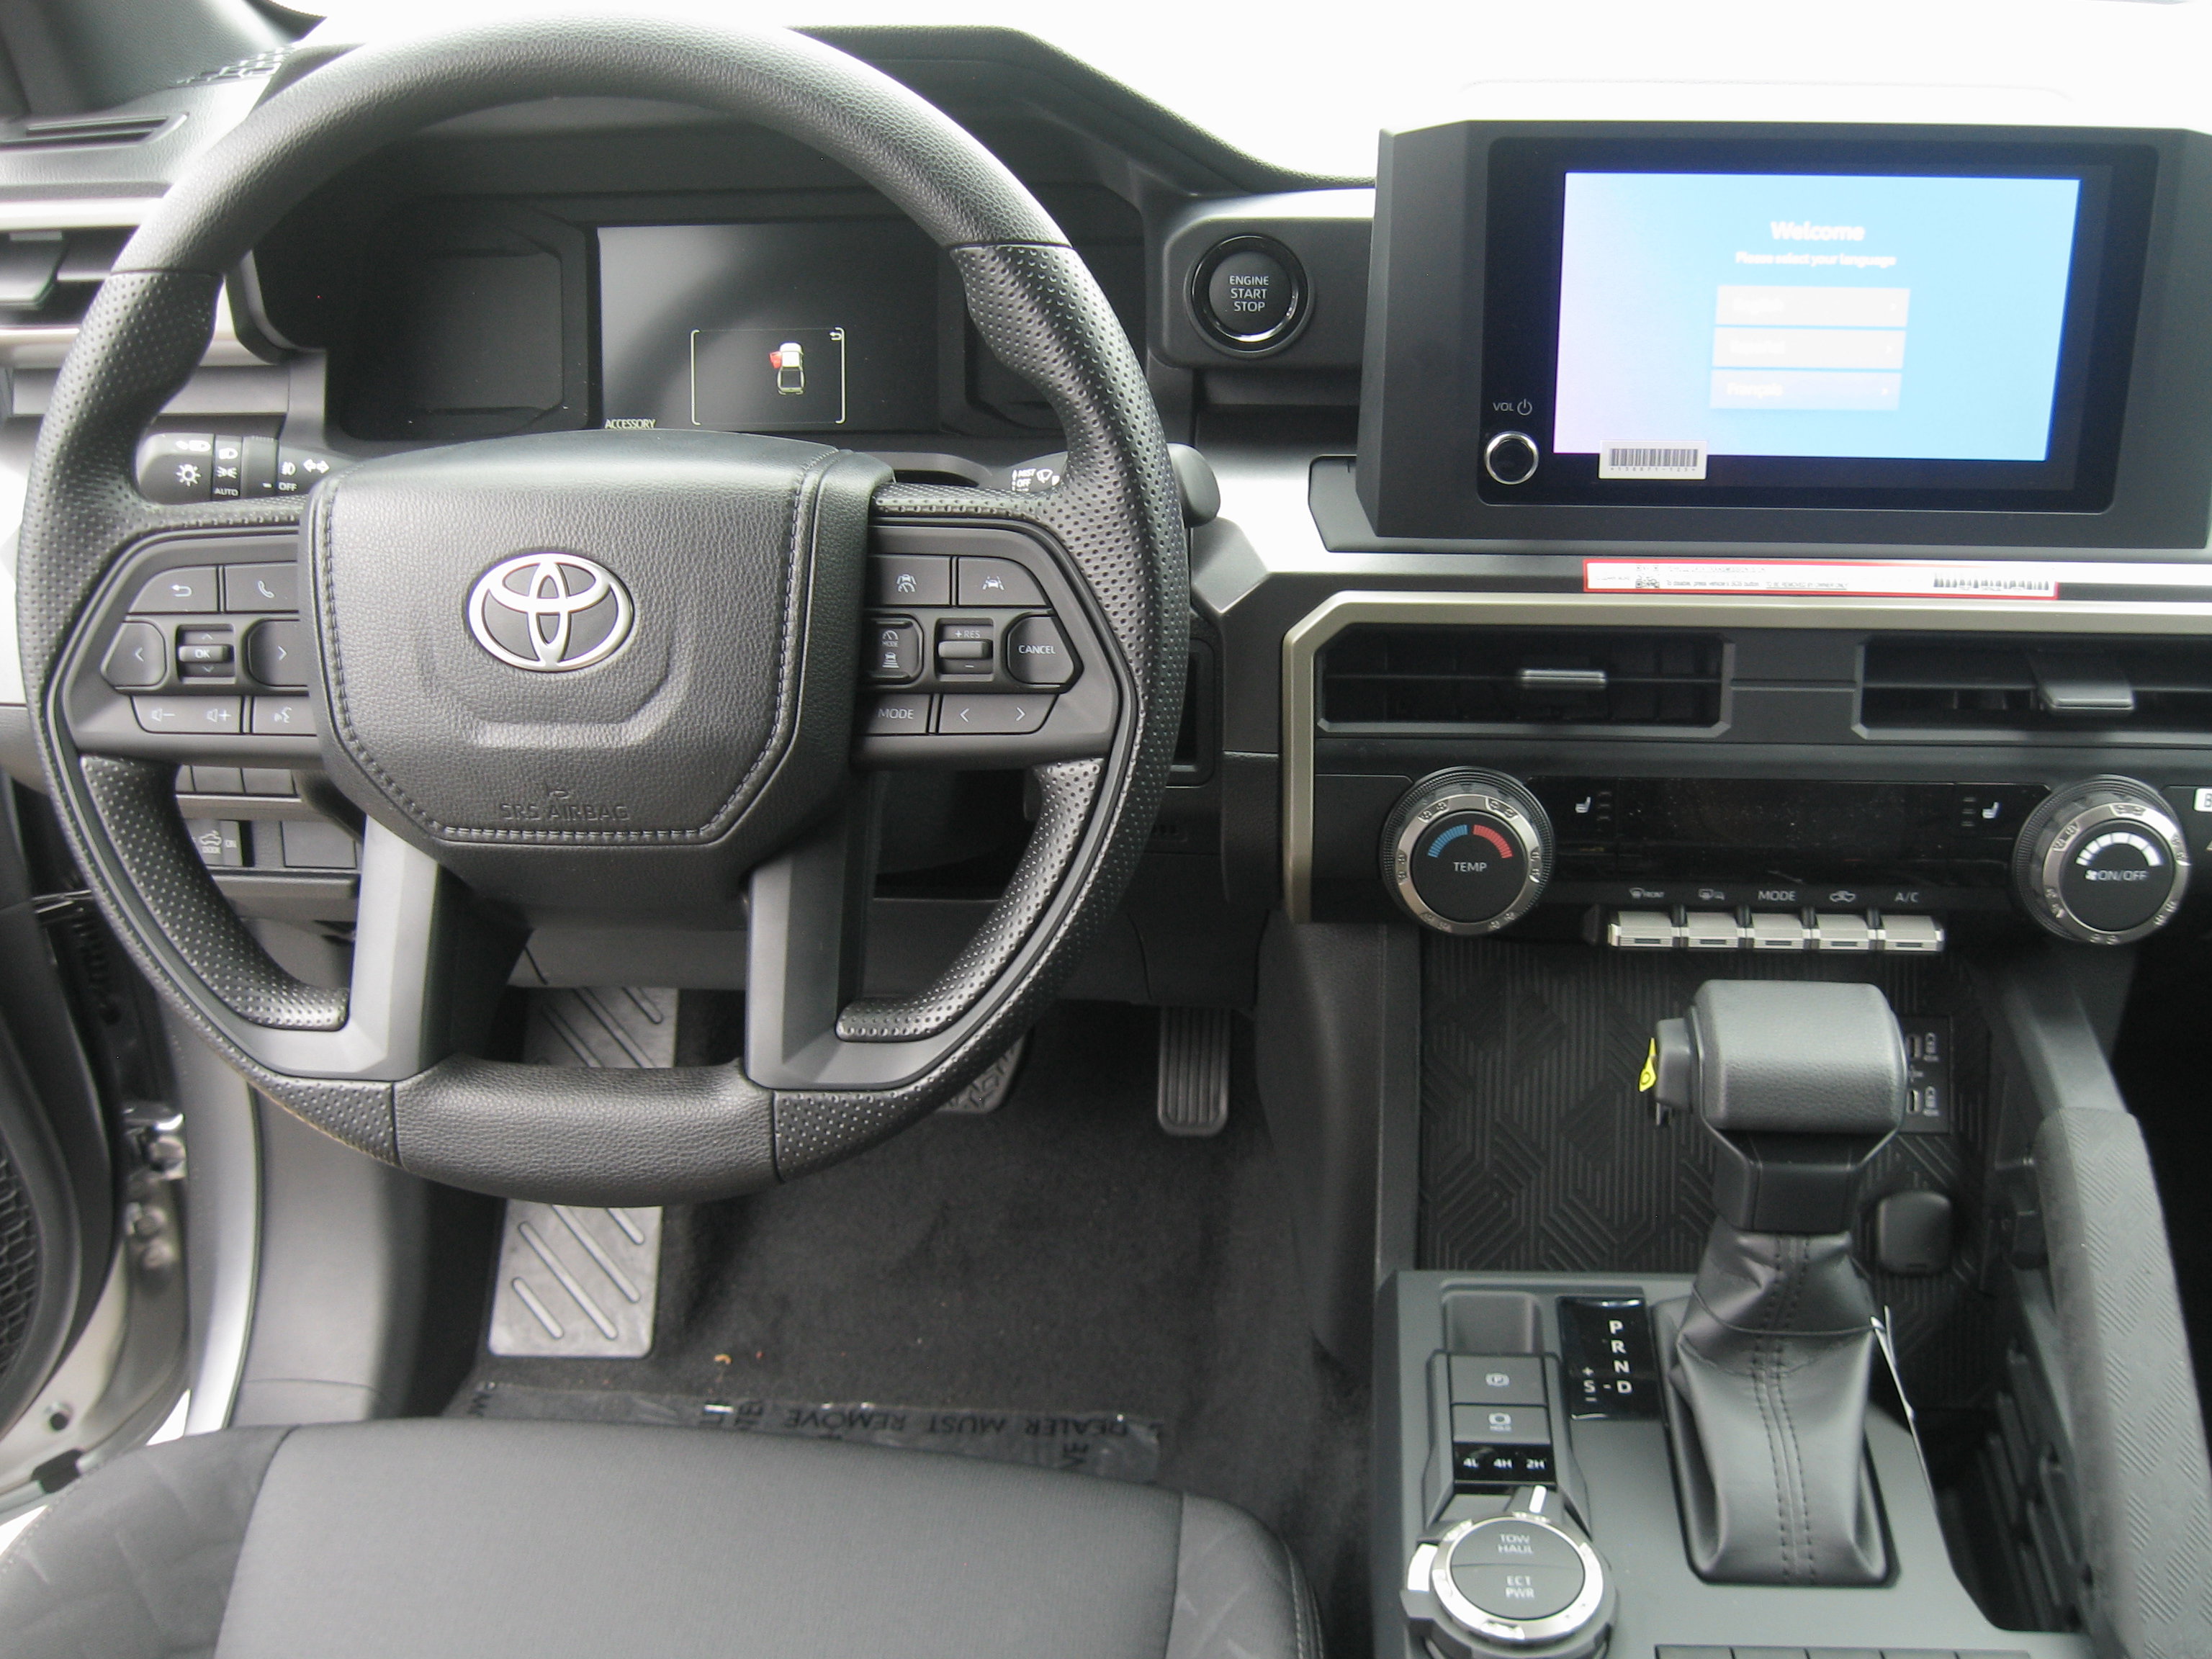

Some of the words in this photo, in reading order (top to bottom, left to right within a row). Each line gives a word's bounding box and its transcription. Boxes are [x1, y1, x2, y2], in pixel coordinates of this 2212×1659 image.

[1770, 221, 1865, 240] Welcome
[1735, 251, 1774, 264] Please
[1775, 252, 1809, 264] select
[1809, 254, 1838, 267] your
[1840, 253, 1897, 269] language
[1229, 275, 1269, 286] ENGINE
[1231, 288, 1267, 300] START
[1233, 301, 1265, 313] STOP
[1492, 403, 1514, 411] VOL
[605, 418, 656, 429] ACCESSORY
[215, 487, 239, 496] AUTO
[278, 482, 298, 492] OFF
[195, 648, 211, 659] OK
[1018, 644, 1056, 655] CANCEL
[878, 709, 914, 719] MODE
[502, 804, 541, 821] SRS
[548, 804, 631, 821] AIRBAG
[1453, 862, 1488, 872] TEMP
[2098, 870, 2147, 881] ON/OFF
[1758, 890, 1797, 901] MODE
[1894, 891, 1920, 903] A/C
[1609, 1319, 1624, 1334] P
[1611, 1339, 1627, 1354] R
[1613, 1359, 1630, 1373] N
[1617, 1380, 1633, 1394] D
[783, 1408, 906, 1431] REMOVE
[928, 1414, 1006, 1434] MUST
[1025, 1416, 1129, 1437] DEALER
[1463, 1457, 1478, 1468] 4L
[1493, 1458, 1514, 1469] 4H
[1526, 1458, 1546, 1469] 2H
[1499, 1533, 1531, 1544] TOW
[1497, 1544, 1534, 1555] HAUL
[1506, 1575, 1532, 1586] ECT
[1505, 1586, 1535, 1599] PWR
